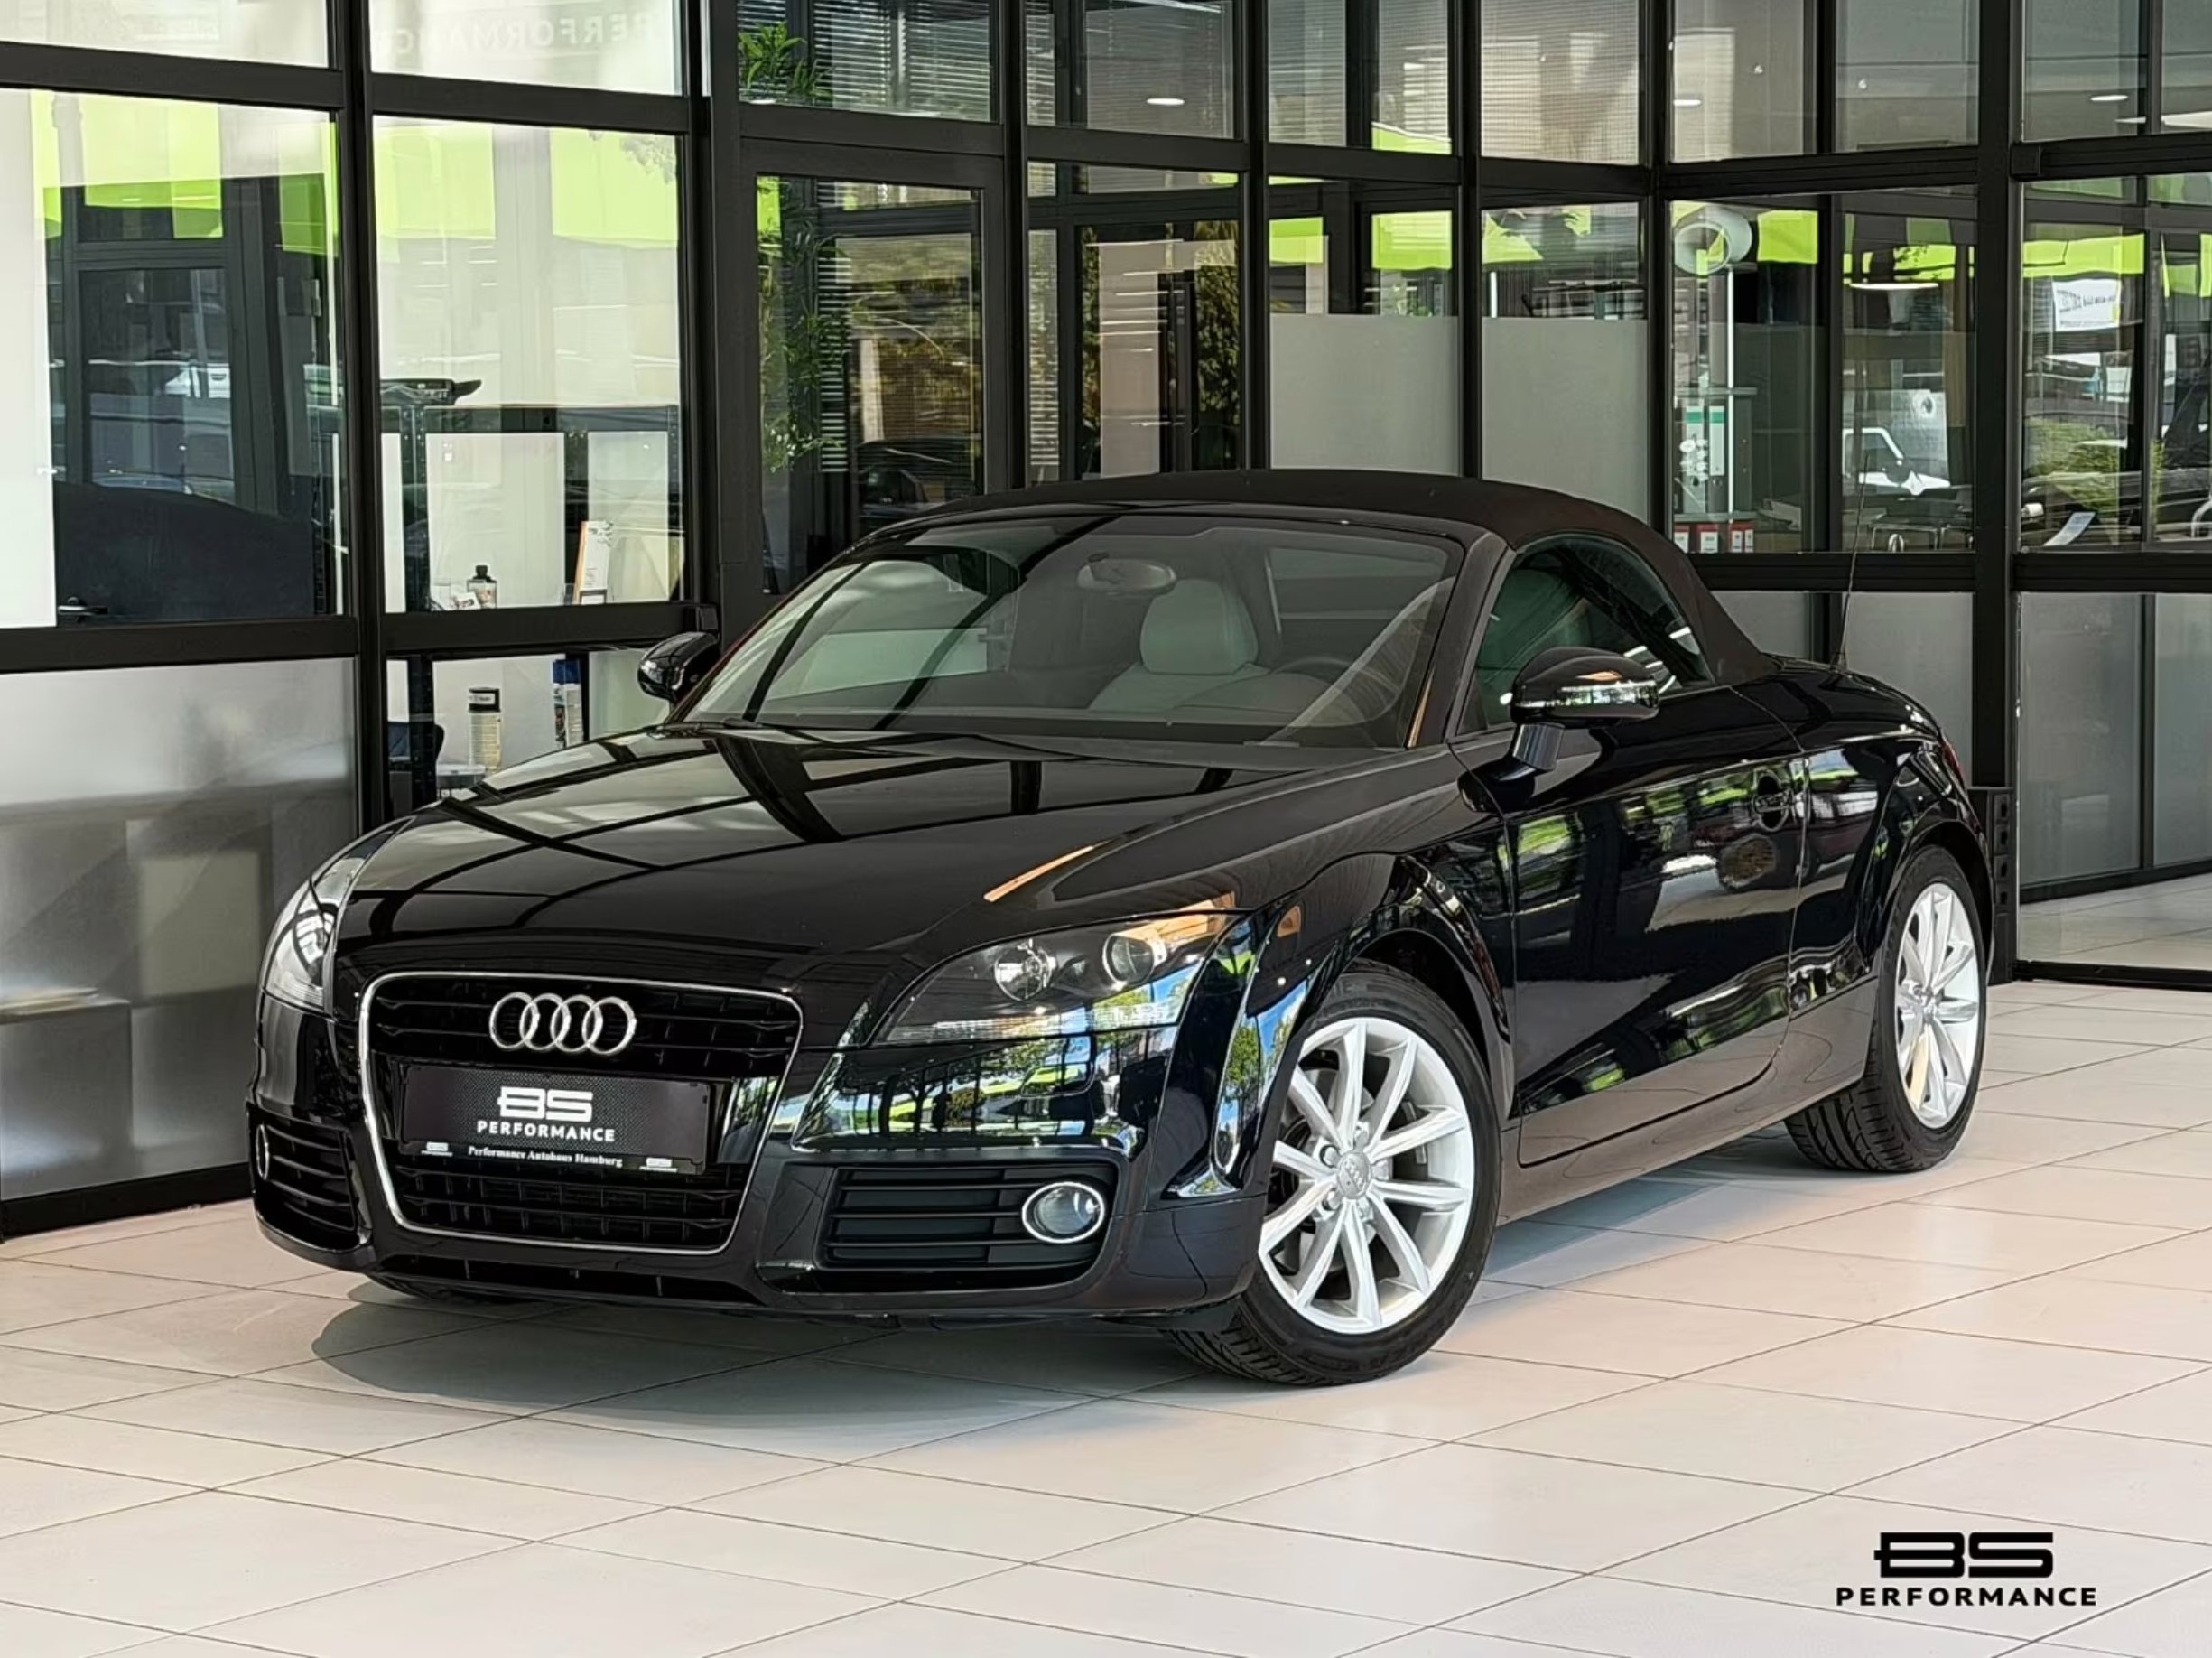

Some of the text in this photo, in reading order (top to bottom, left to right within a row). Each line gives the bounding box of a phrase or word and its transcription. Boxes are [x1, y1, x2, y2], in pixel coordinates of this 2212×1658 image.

[497, 1086, 593, 1122] BS
[477, 1120, 616, 1142] PERFORMANCE
[468, 1145, 526, 1160] Performance
[527, 1150, 573, 1163] Autohaus
[575, 1153, 623, 1168] Hamburg
